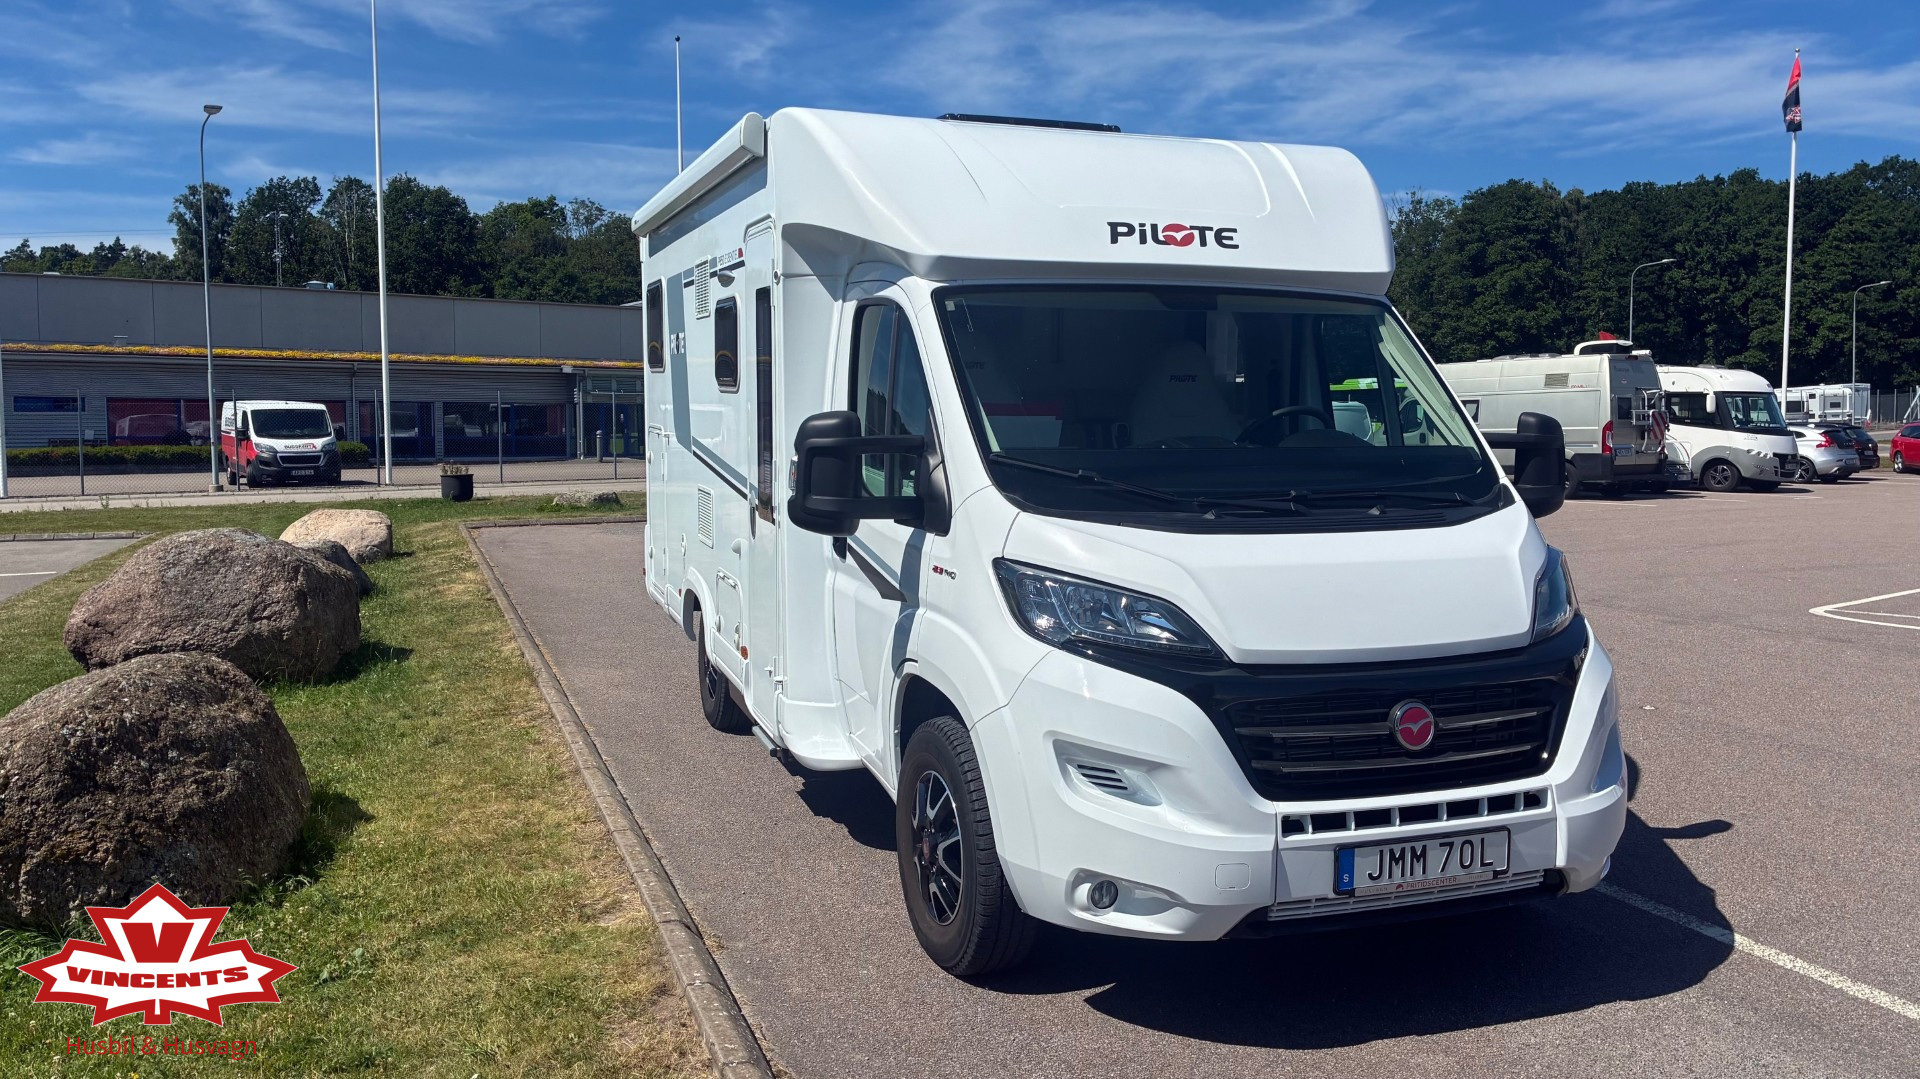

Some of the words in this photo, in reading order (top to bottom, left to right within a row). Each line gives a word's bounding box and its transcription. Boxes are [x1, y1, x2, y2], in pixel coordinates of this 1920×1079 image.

[1367, 844, 1428, 881] JMM
[1438, 837, 1494, 873] 70L
[1343, 873, 1350, 883] S
[1405, 877, 1457, 890] FRITIDSCENTER
